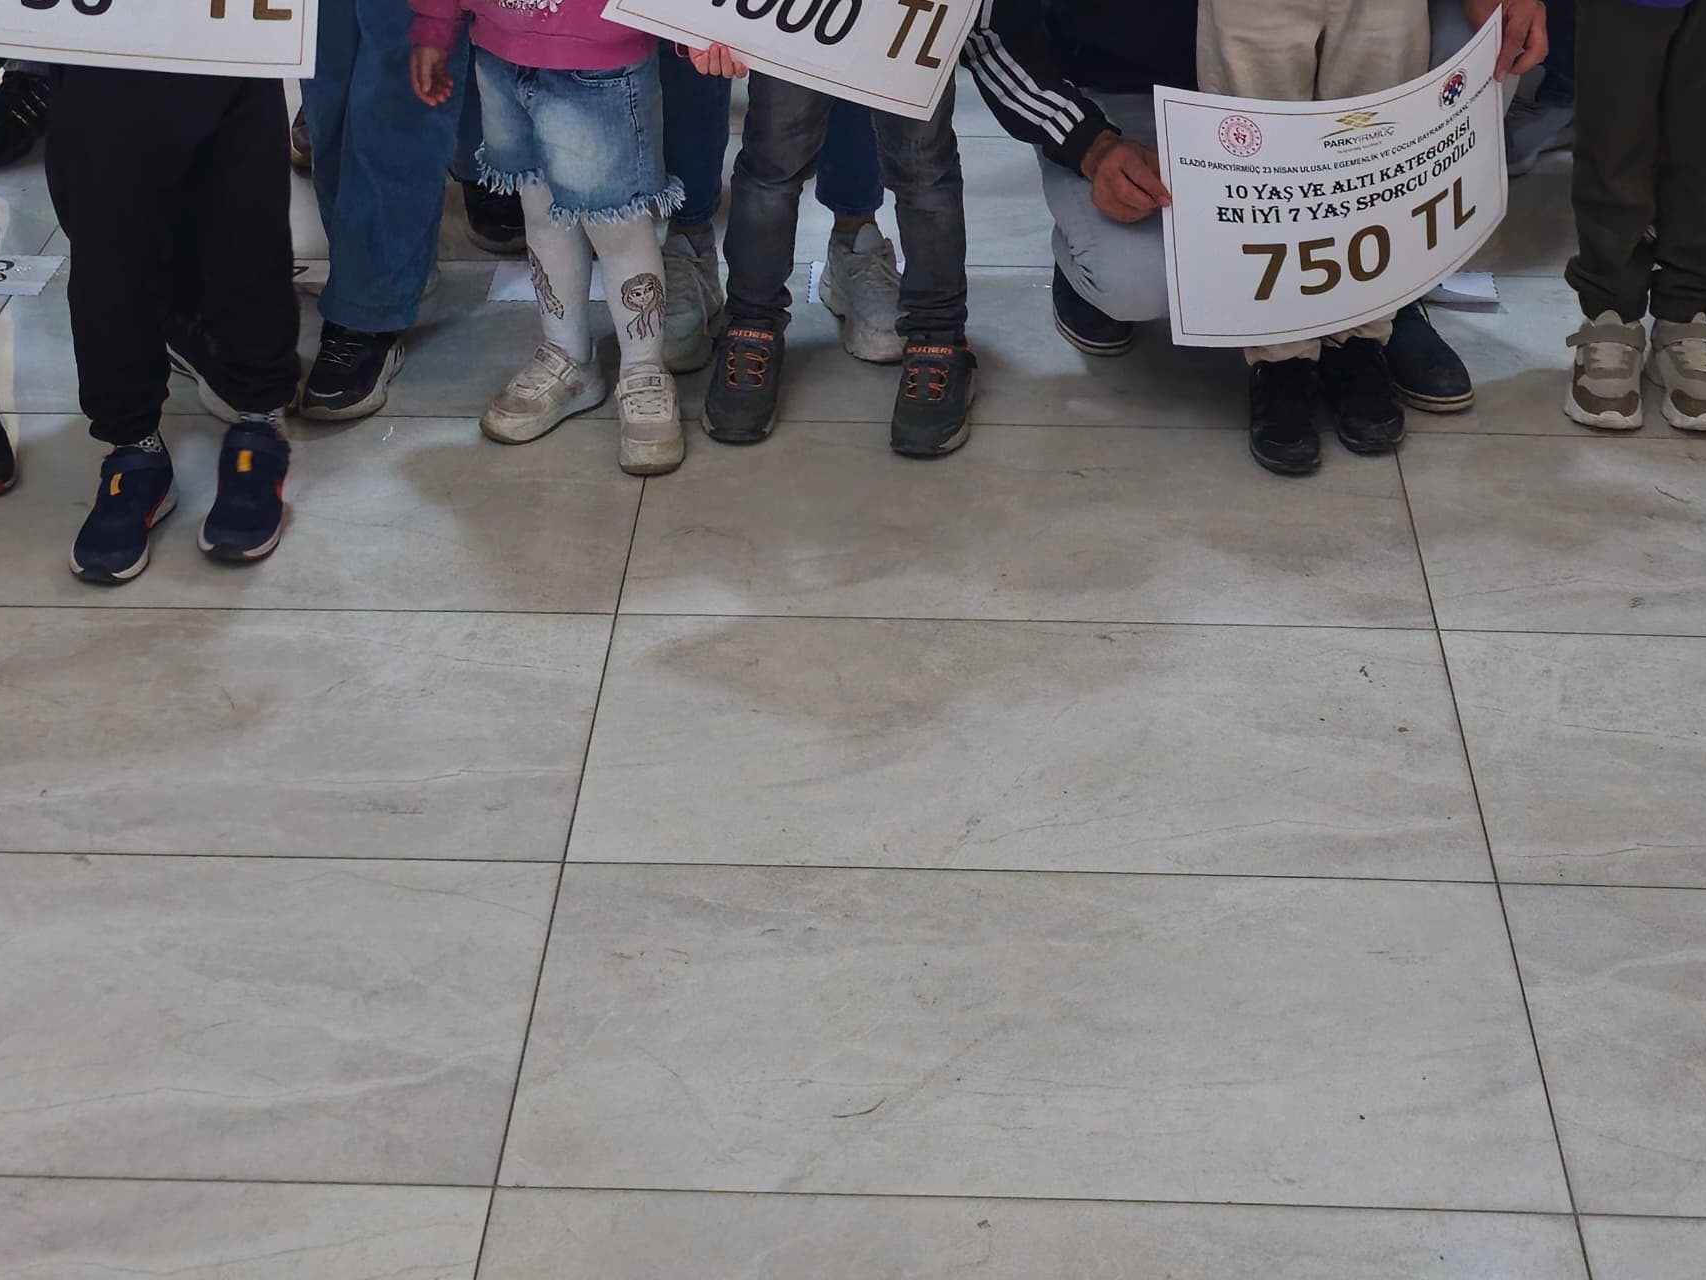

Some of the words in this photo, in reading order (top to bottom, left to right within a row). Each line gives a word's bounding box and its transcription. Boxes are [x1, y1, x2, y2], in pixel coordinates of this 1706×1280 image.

[1216, 207, 1244, 223] EN
[1252, 205, 1281, 223] İYİ
[1288, 208, 1300, 222] 7
[1307, 200, 1350, 221] YAŞ
[1356, 174, 1428, 211] SPORCU
[1432, 131, 1476, 178] ÖDÜLÜ
[1224, 184, 1248, 199] 10
[1252, 185, 1294, 202] YAŞ
[1298, 182, 1325, 198] VE
[1332, 174, 1375, 193] ALTI
[1379, 117, 1470, 182] KATEGORİSİ
[1242, 224, 1391, 301] 750
[1412, 176, 1476, 251] TL
